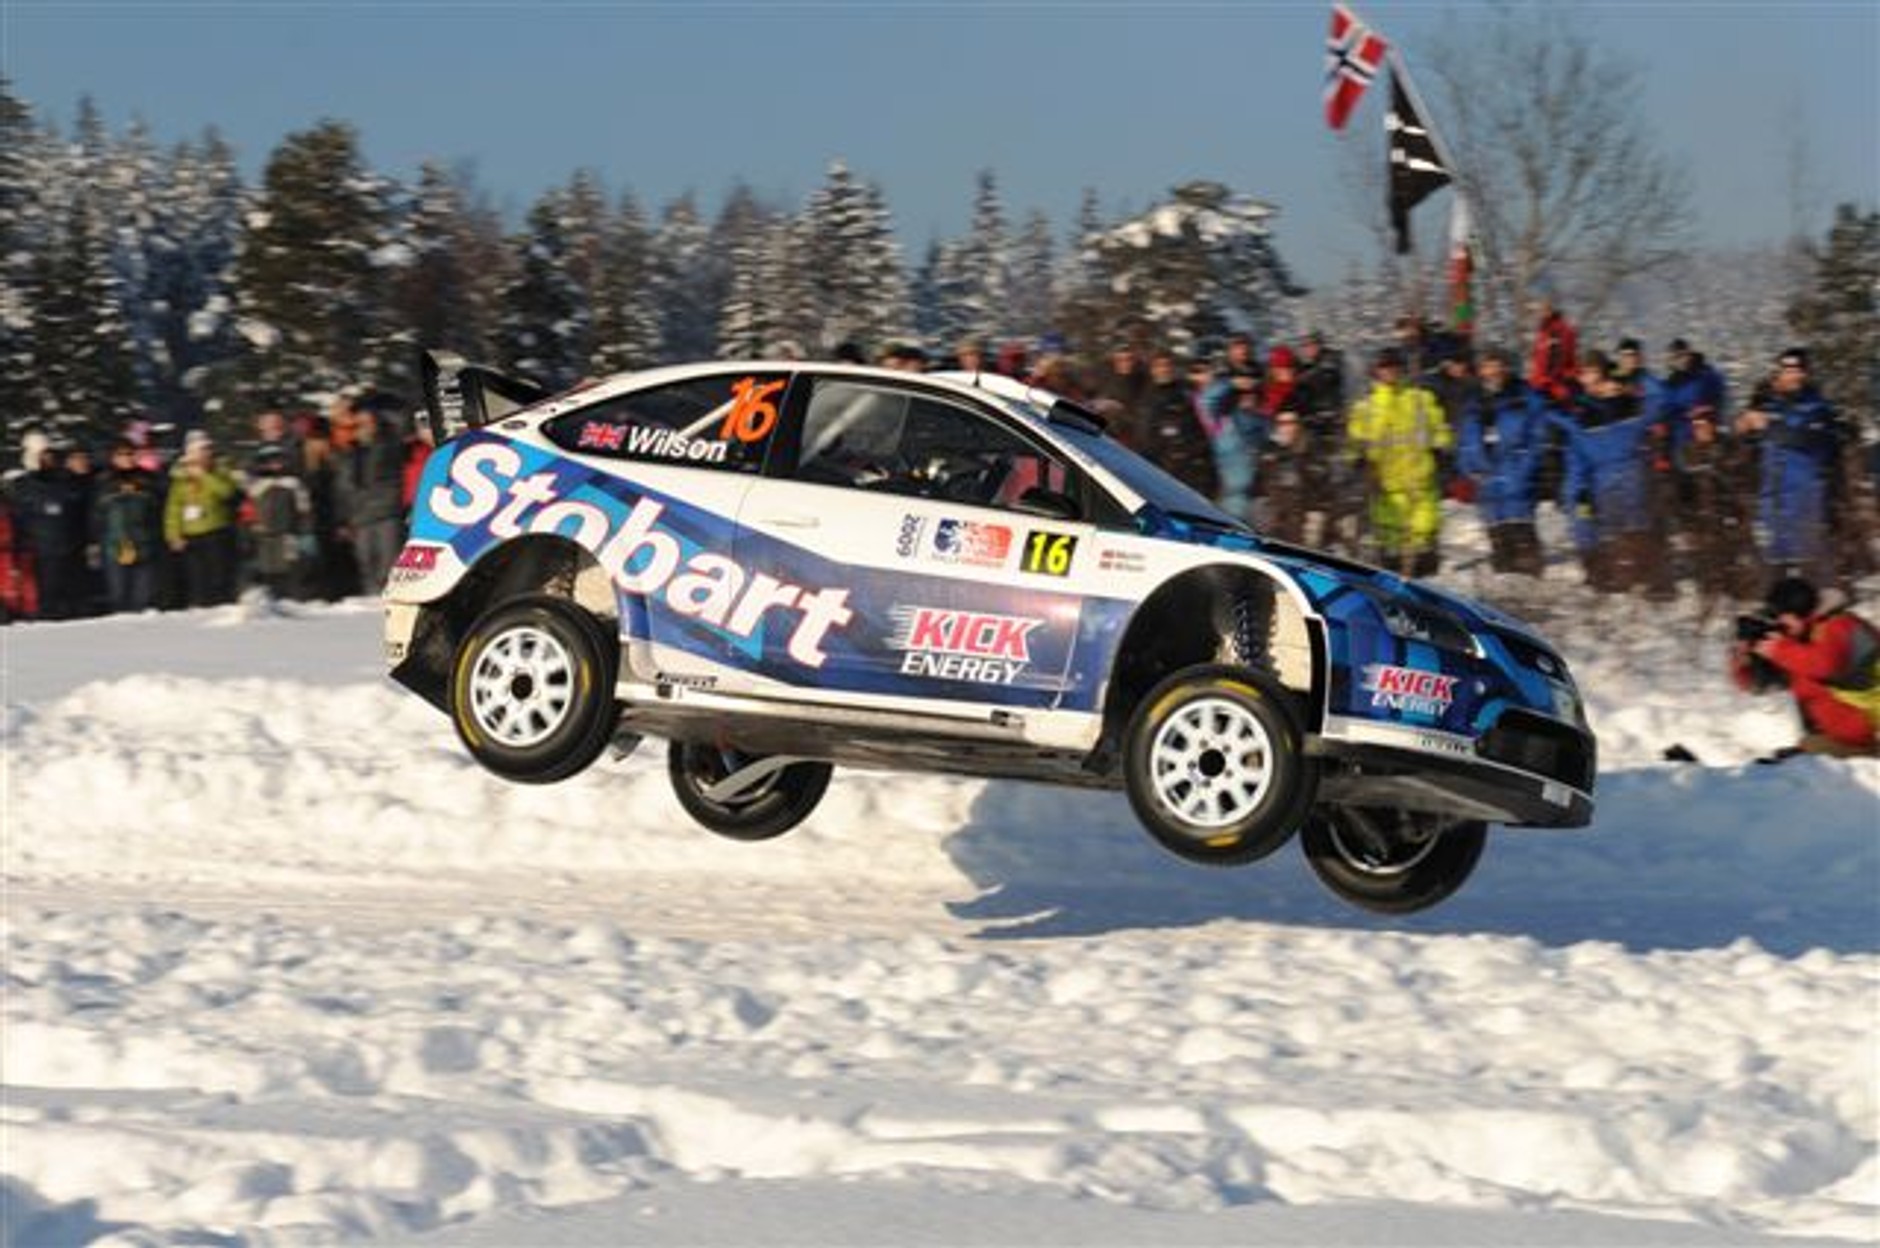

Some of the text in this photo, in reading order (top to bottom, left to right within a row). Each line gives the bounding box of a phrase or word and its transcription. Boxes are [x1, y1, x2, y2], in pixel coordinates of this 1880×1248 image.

[720, 376, 784, 442] 16
[627, 425, 727, 461] Wilson
[429, 441, 852, 668] Stobart
[896, 513, 921, 557] 2009
[1030, 534, 1069, 575] 16
[910, 608, 1040, 661] KICK
[902, 653, 1026, 684] ENERGY
[1379, 667, 1451, 701] KICK
